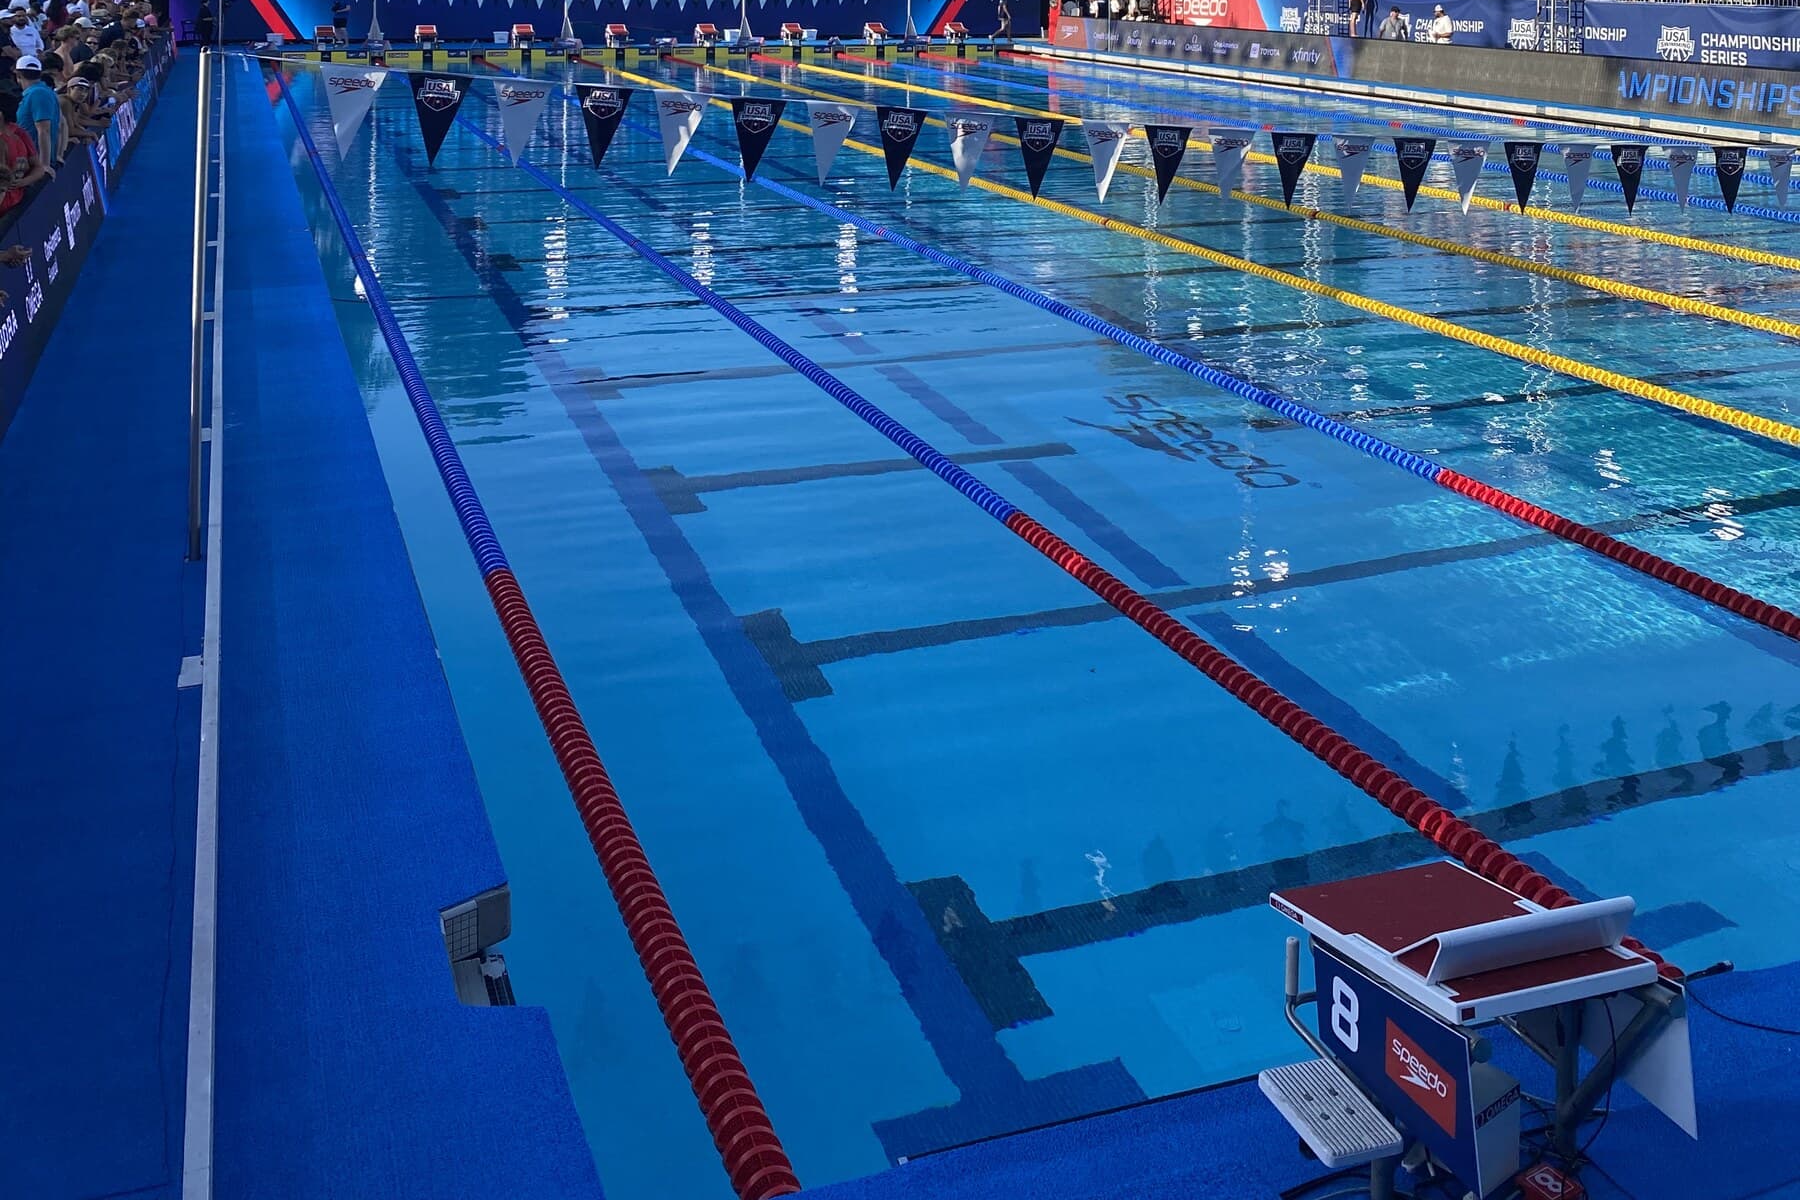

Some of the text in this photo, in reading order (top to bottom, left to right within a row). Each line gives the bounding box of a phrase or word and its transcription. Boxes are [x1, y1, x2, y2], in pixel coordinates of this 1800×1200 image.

[1514, 22, 1532, 34] USA
[1665, 31, 1686, 42] USA
[1701, 49, 1748, 66] SERIES
[329, 76, 376, 89] speedo
[426, 82, 451, 92] USA
[501, 89, 545, 100] speedo
[591, 90, 617, 100] USA
[661, 99, 703, 112] speedo
[747, 105, 768, 115] USA
[813, 110, 852, 123] speedo
[891, 114, 912, 125] USA
[951, 121, 988, 132] speedo
[1029, 125, 1050, 135] USA
[1088, 129, 1124, 140] speedo
[1159, 132, 1177, 141] USA
[1286, 139, 1303, 147] USA
[1103, 393, 1300, 489] speedo
[1331, 975, 1360, 1053] 8
[1391, 1038, 1448, 1099] speedo
[1486, 1088, 1519, 1120] OMEGA
[1534, 1172, 1563, 1193] 8
